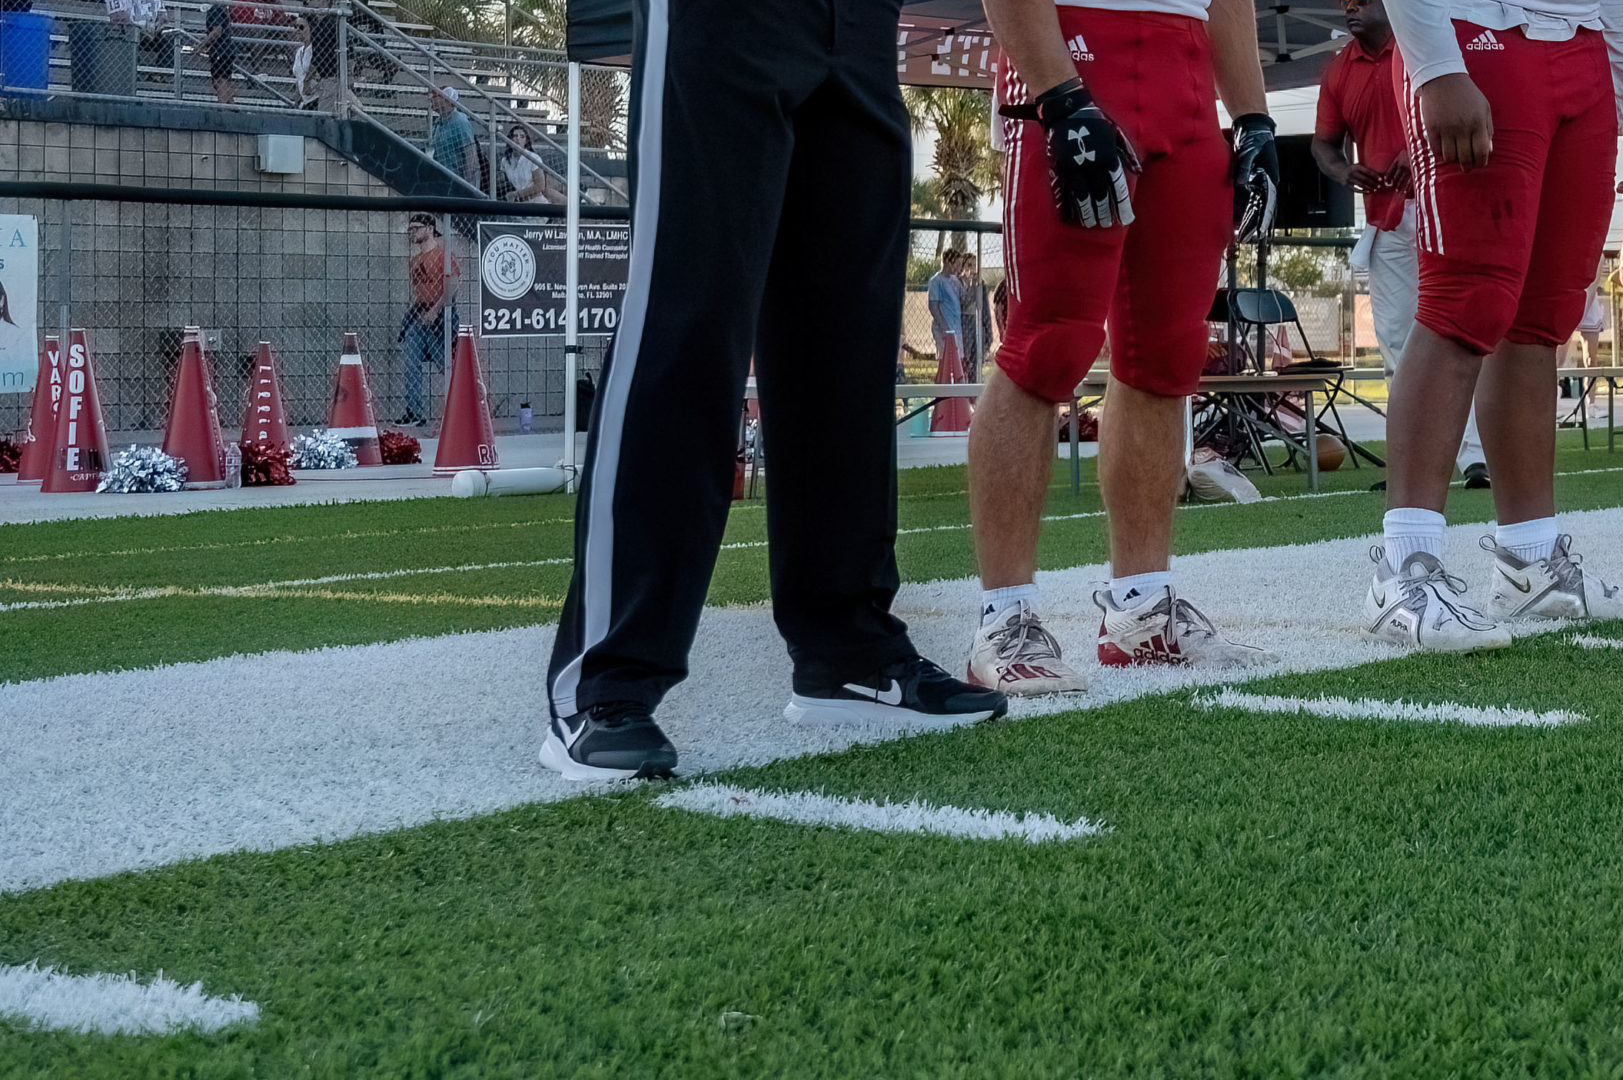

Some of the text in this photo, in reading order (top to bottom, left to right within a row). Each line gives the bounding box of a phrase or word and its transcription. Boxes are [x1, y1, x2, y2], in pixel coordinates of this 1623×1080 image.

[1072, 50, 1095, 61] das
[1466, 42, 1505, 51] adidas
[523, 230, 543, 241] Jerry
[544, 230, 553, 239] W
[606, 231, 629, 240] LMHC
[488, 245, 500, 263] YOU
[483, 307, 621, 330] 321-614170
[66, 343, 85, 471] SOFIE
[257, 365, 272, 441] Lillia
